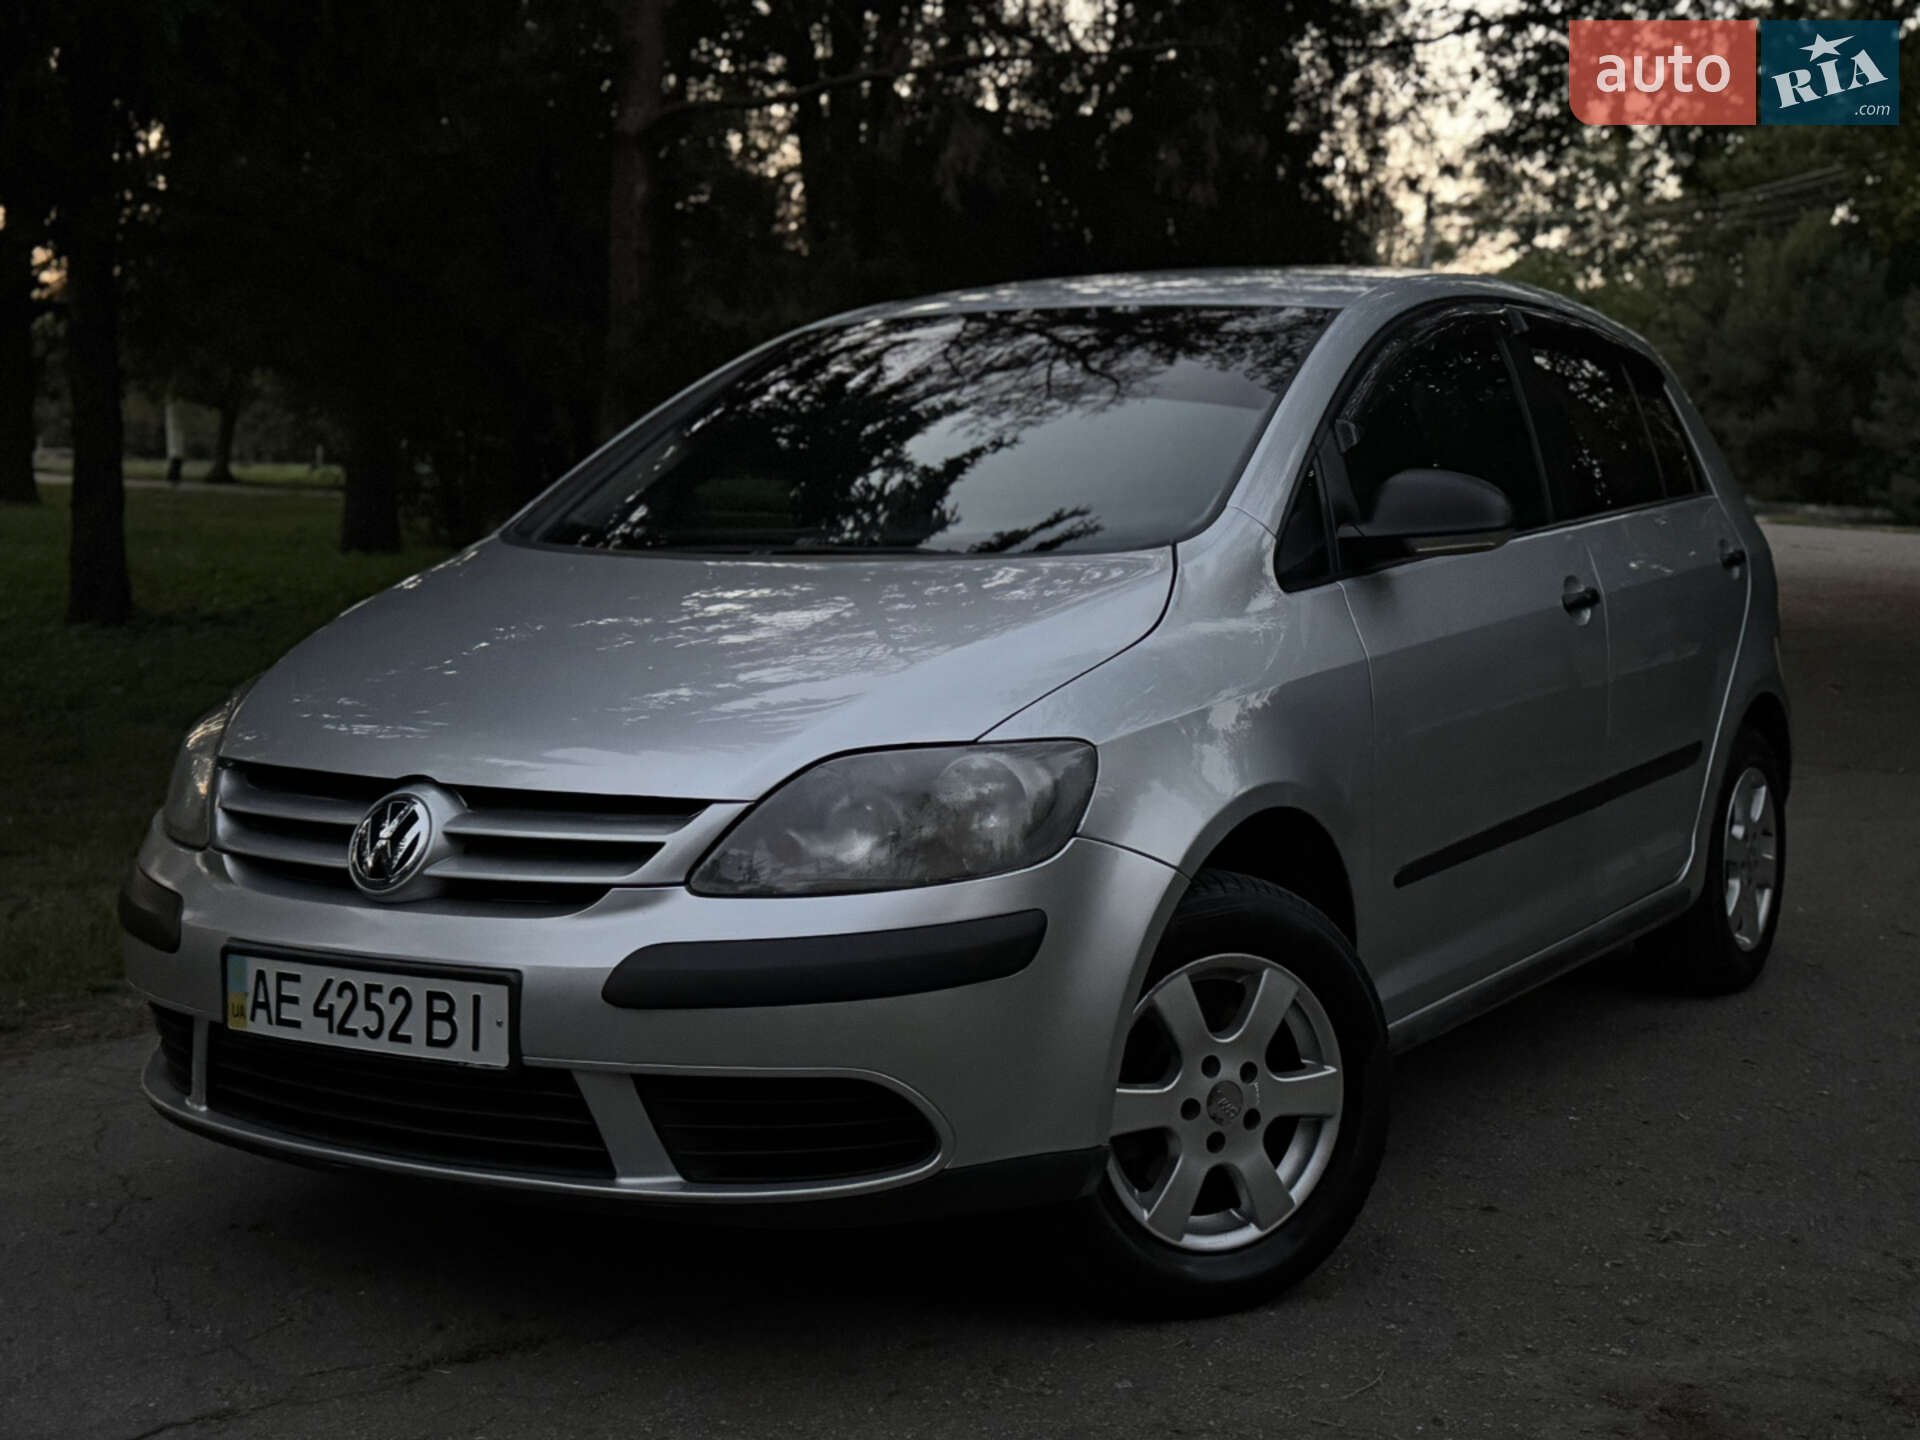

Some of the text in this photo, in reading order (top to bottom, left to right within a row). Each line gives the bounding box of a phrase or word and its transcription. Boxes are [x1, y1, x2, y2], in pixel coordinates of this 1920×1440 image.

[231, 1004, 246, 1019] UA
[250, 969, 301, 1028] AE
[312, 979, 412, 1043] 4252
